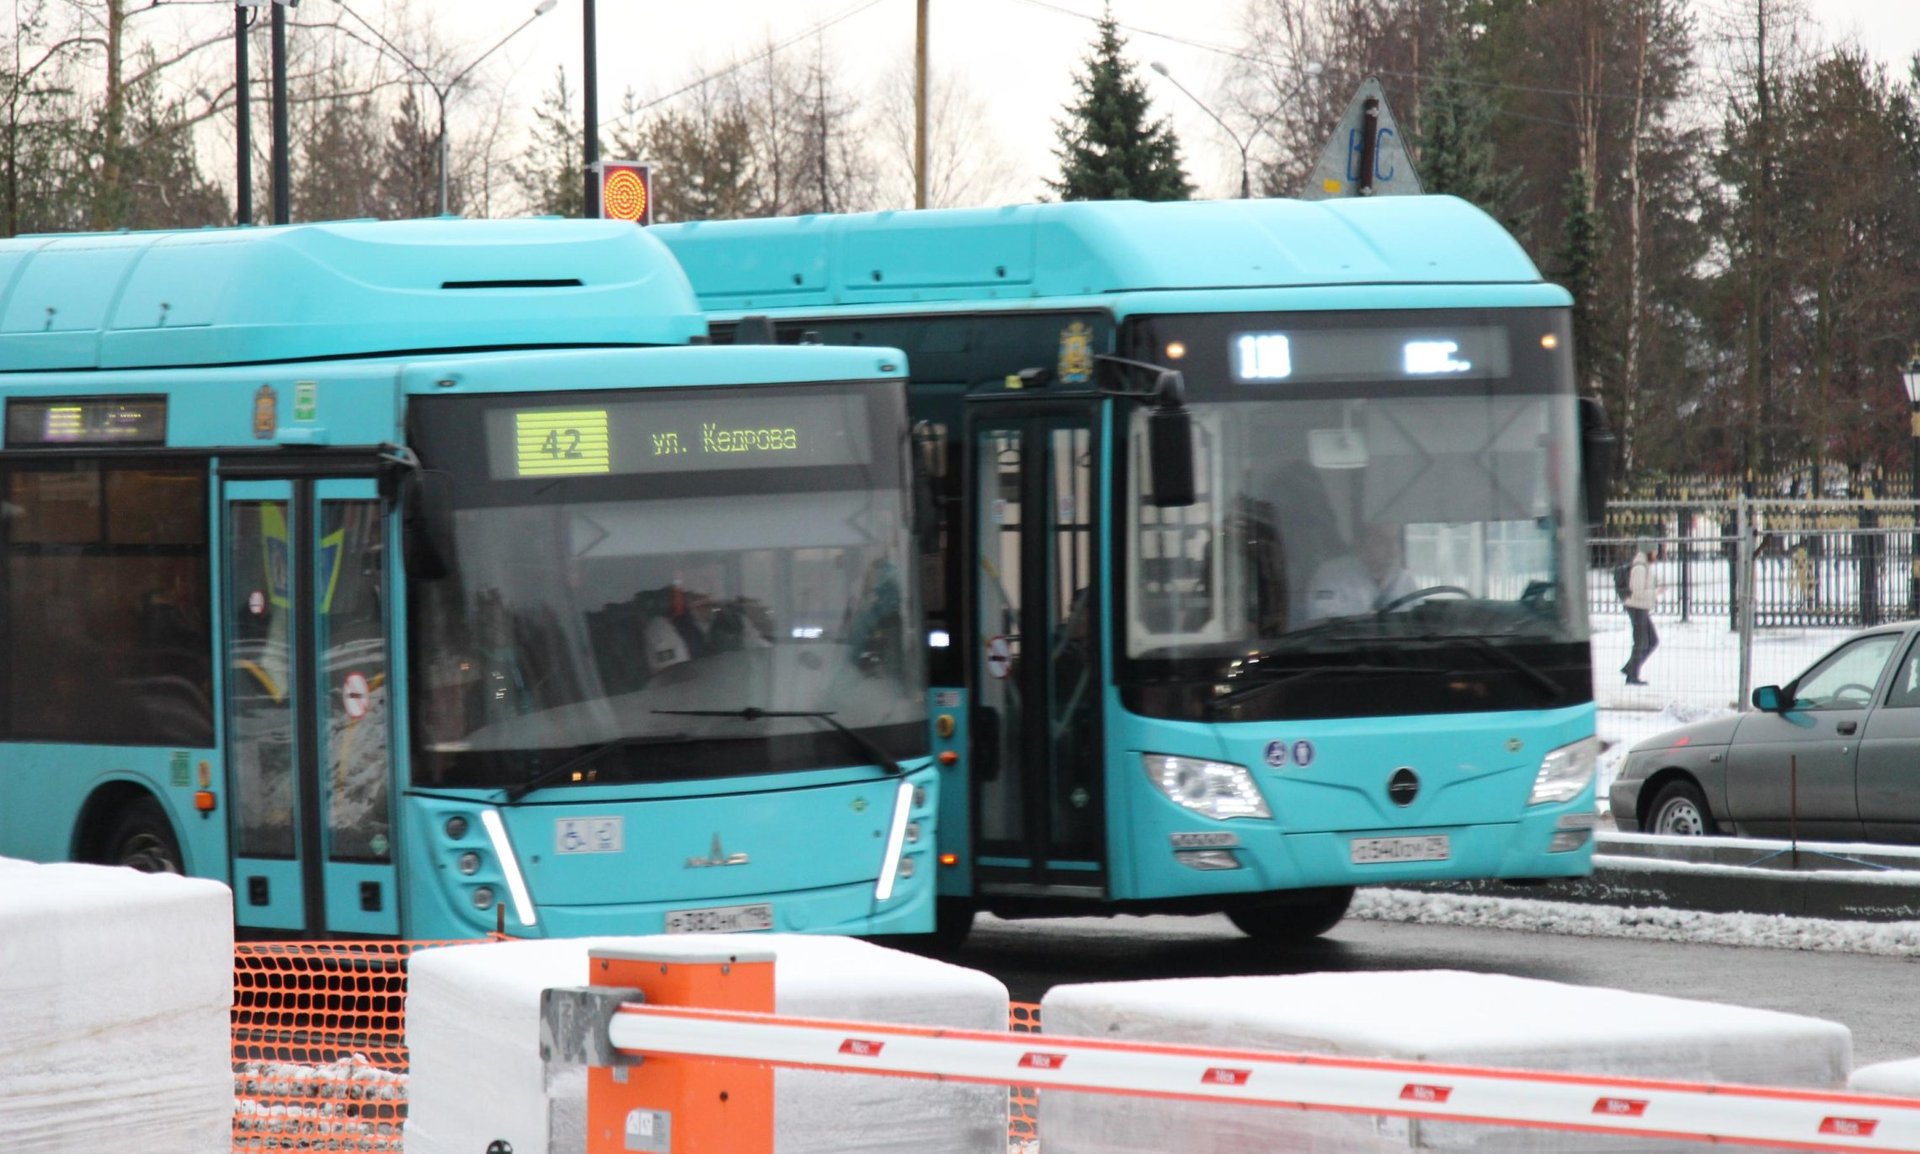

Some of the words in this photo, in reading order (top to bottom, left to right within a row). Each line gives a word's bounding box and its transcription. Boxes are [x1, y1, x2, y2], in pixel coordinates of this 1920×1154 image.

[541, 428, 583, 460] 42
[653, 432, 687, 456] ул.
[703, 423, 797, 453] Кедрова
